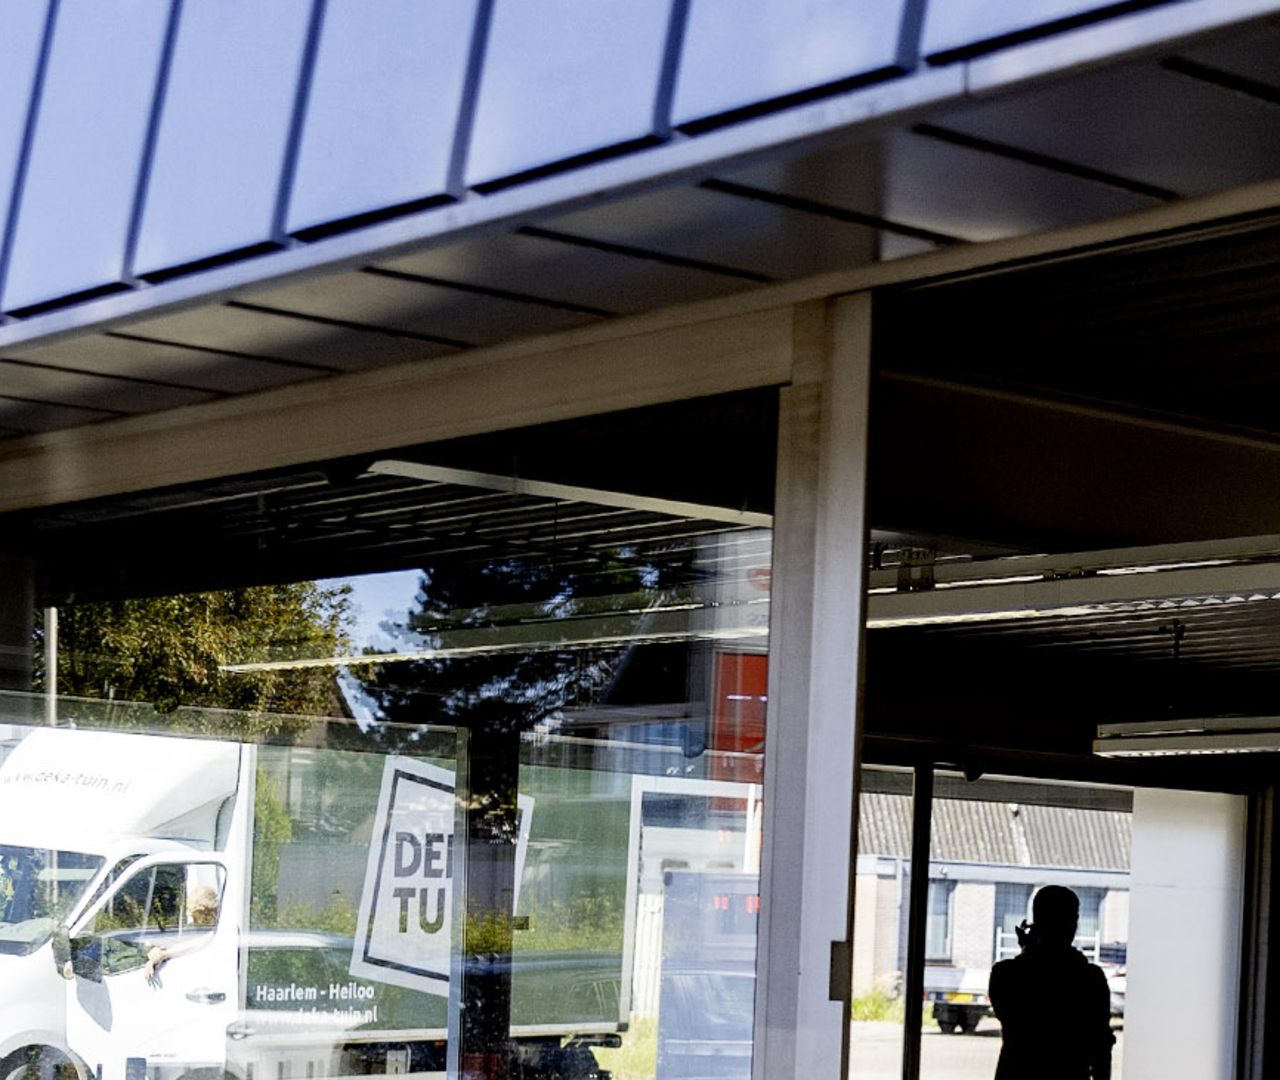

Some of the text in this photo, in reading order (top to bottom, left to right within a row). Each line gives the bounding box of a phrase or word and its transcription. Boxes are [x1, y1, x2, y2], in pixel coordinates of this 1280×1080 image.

[393, 832, 454, 878] DE
[393, 888, 446, 934] TU
[256, 983, 317, 1001] Haarlem
[329, 982, 375, 1000] Heiloo
